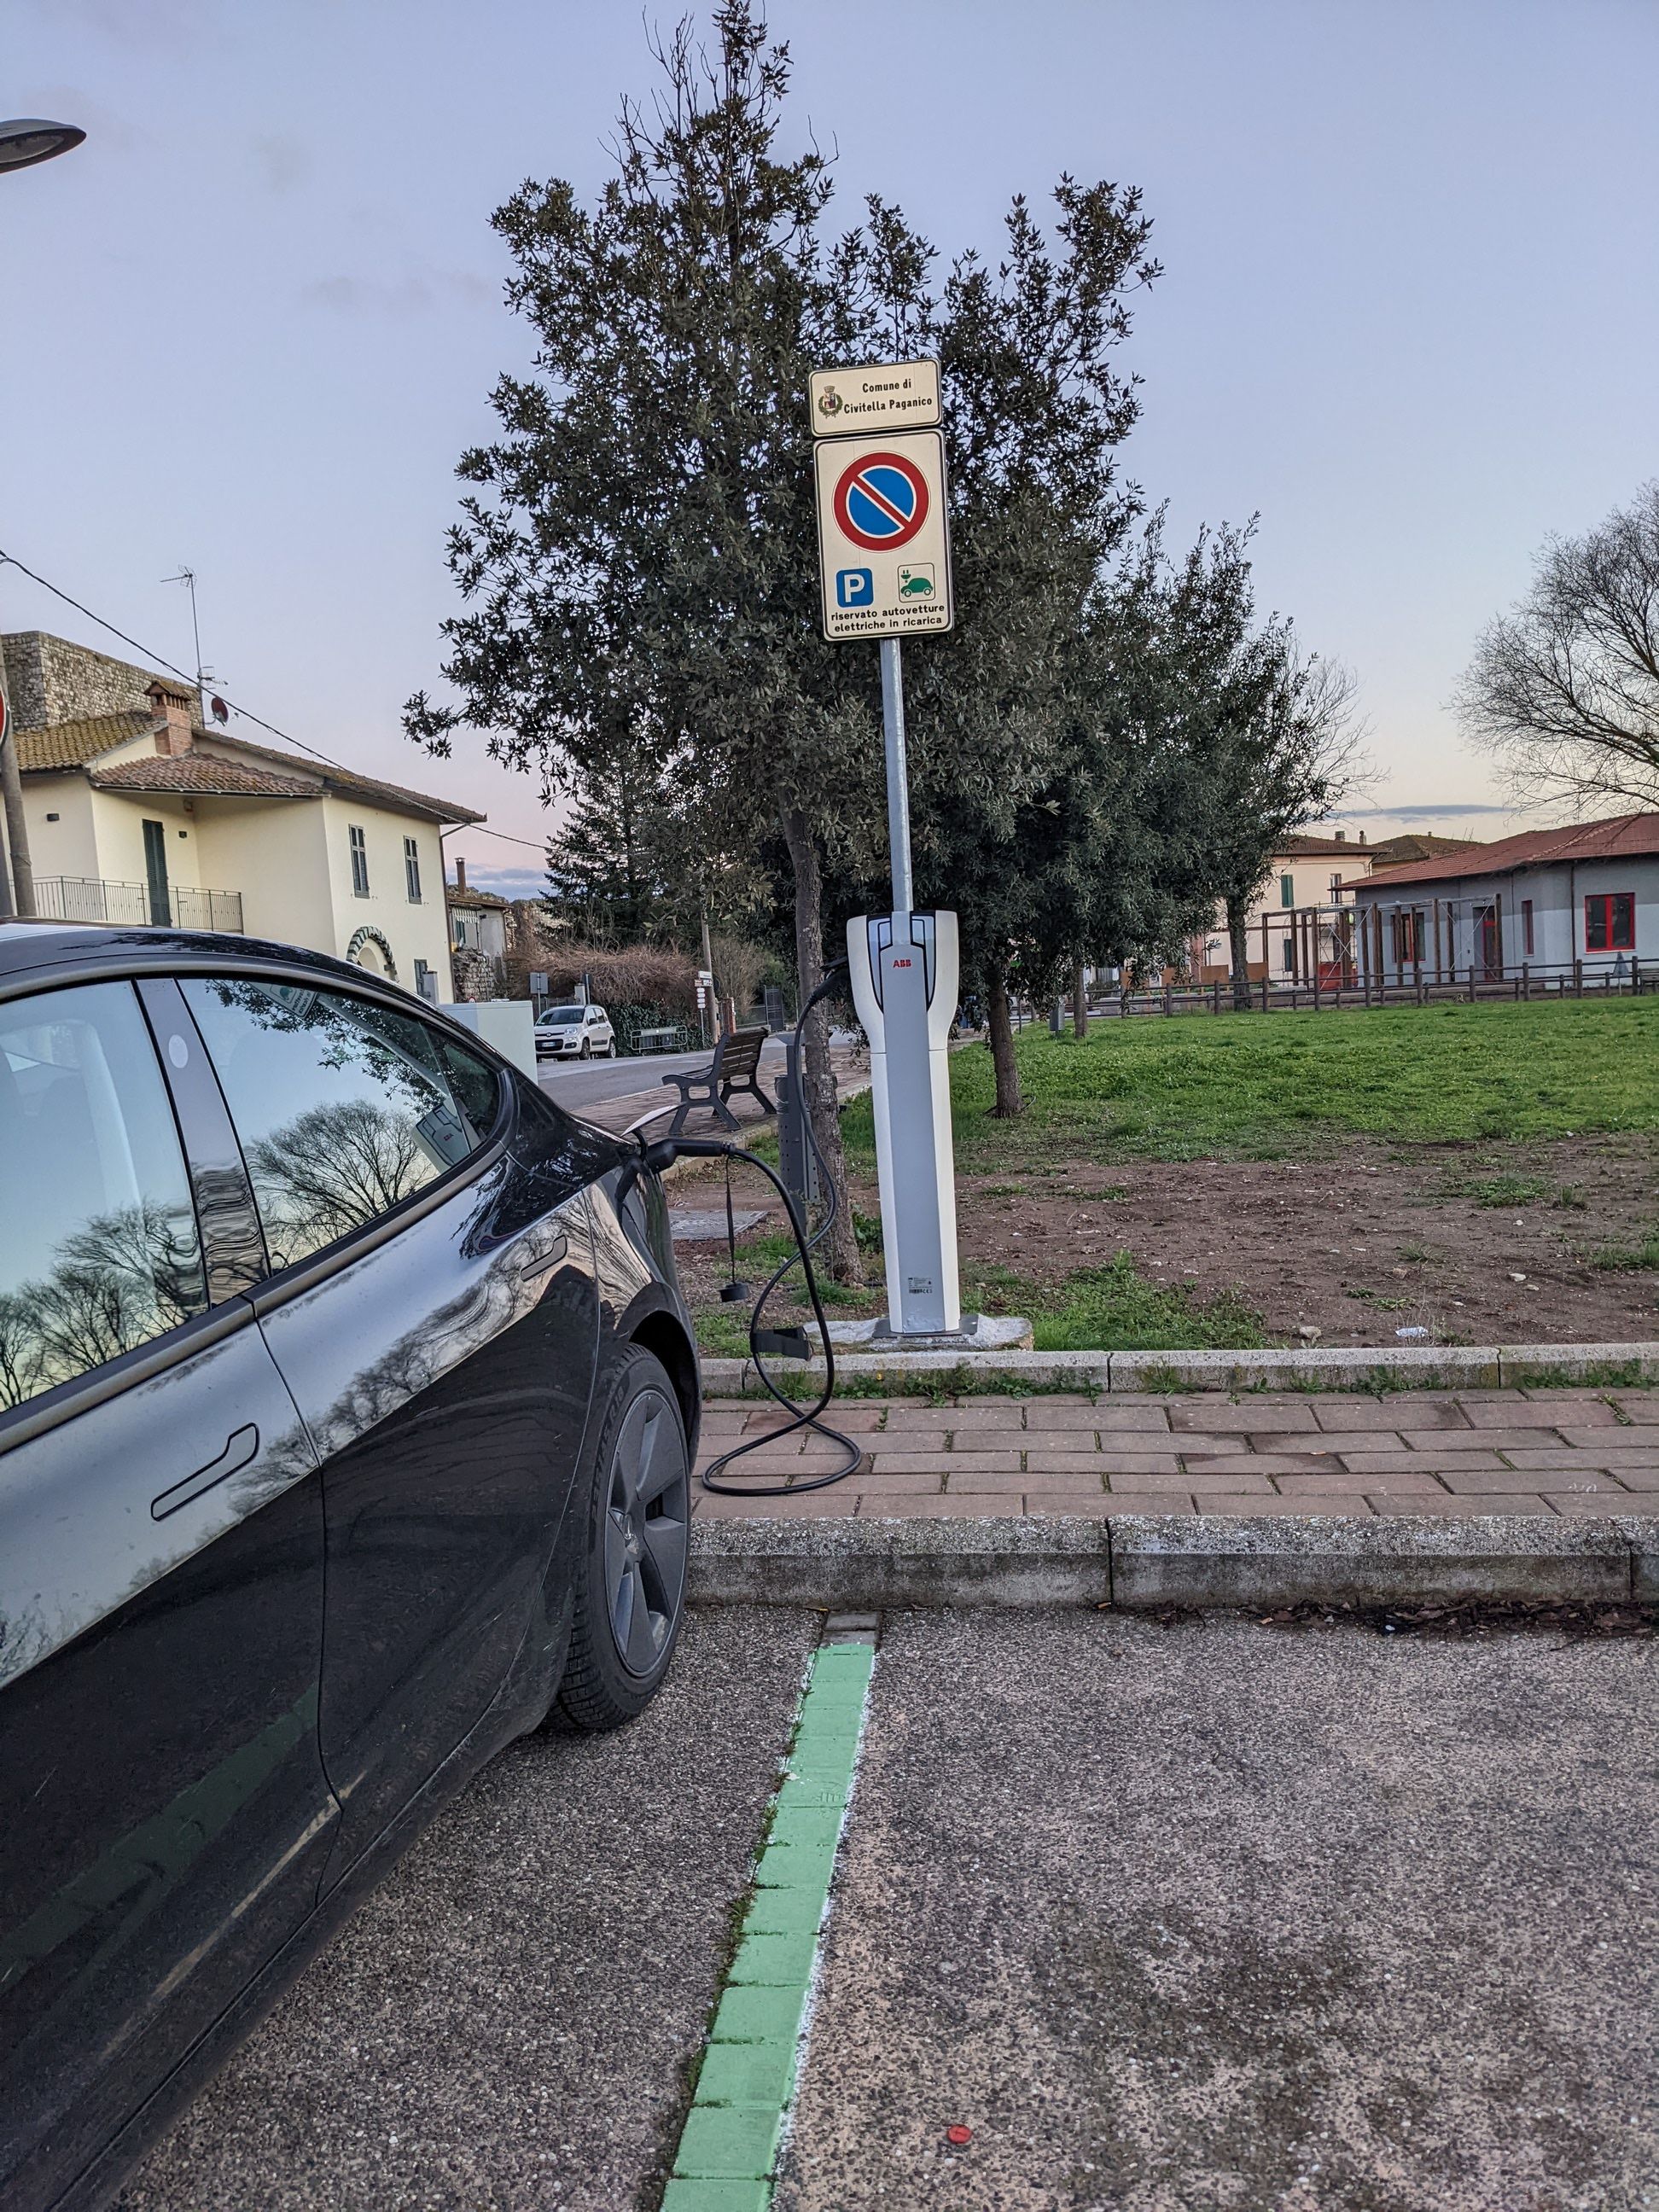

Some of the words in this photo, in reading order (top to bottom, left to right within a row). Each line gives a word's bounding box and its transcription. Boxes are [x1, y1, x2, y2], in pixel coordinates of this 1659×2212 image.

[863, 382, 899, 393] Comune
[903, 378, 911, 388] di
[844, 401, 886, 414] Civitella
[889, 397, 932, 410] Paganico
[843, 573, 865, 603] P
[831, 609, 877, 620] riservato
[882, 604, 945, 617] autovetture
[835, 620, 885, 632] elettriche
[890, 619, 899, 628] in
[903, 616, 942, 626] ricarica
[893, 959, 911, 968] ABB
